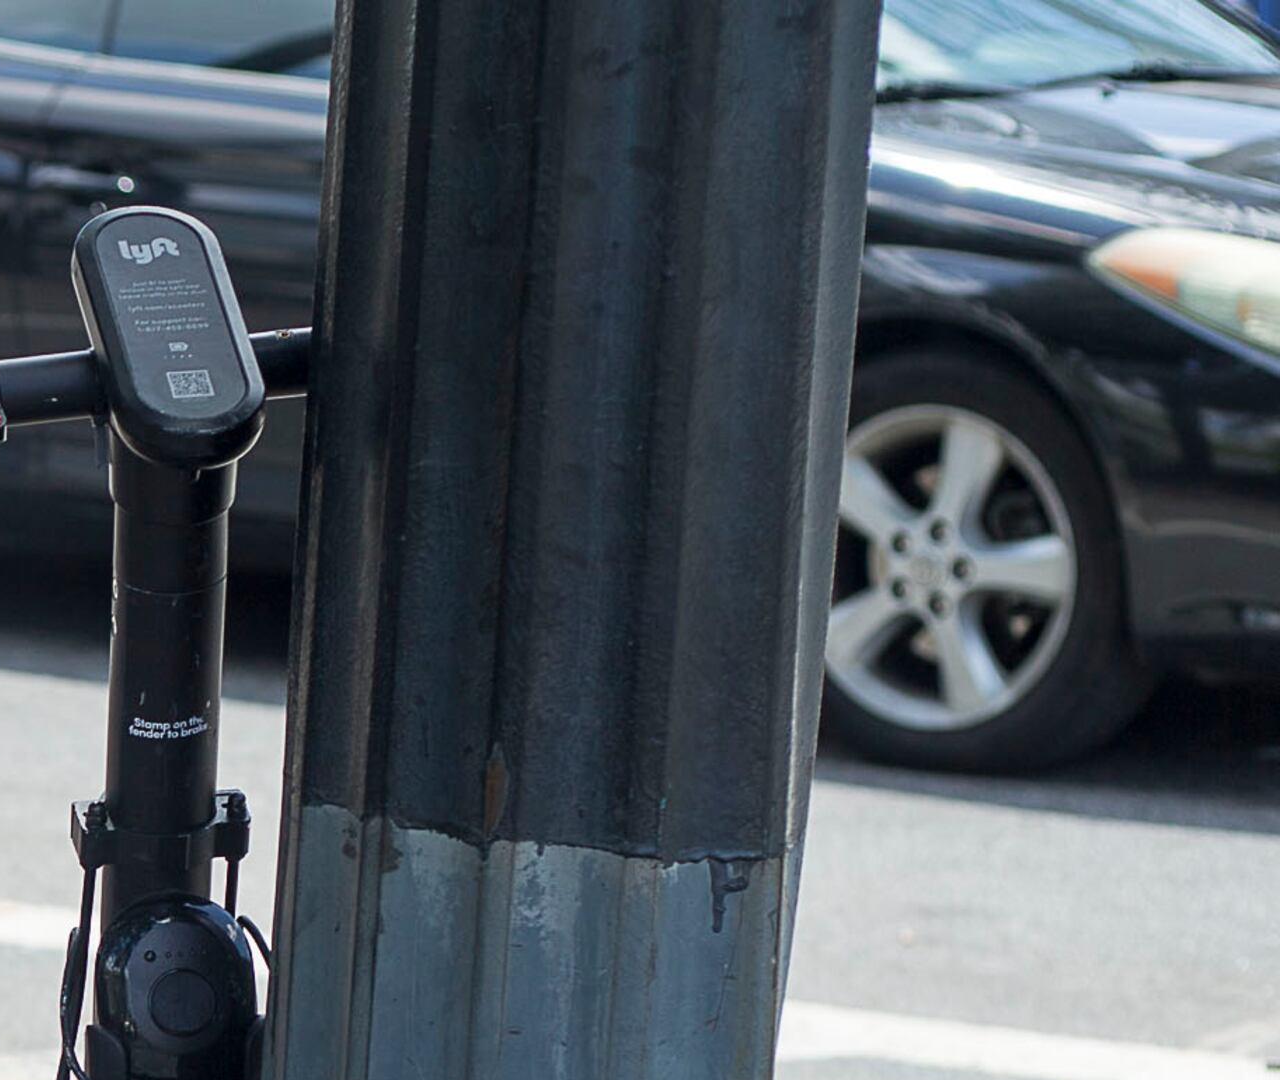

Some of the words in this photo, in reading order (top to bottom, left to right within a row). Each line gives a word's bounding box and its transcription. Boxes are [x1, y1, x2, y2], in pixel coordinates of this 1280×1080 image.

[118, 237, 180, 264] lyft
[128, 725, 165, 739] fender
[167, 730, 179, 738] to
[134, 717, 170, 732] Stamp
[173, 720, 187, 729] on
